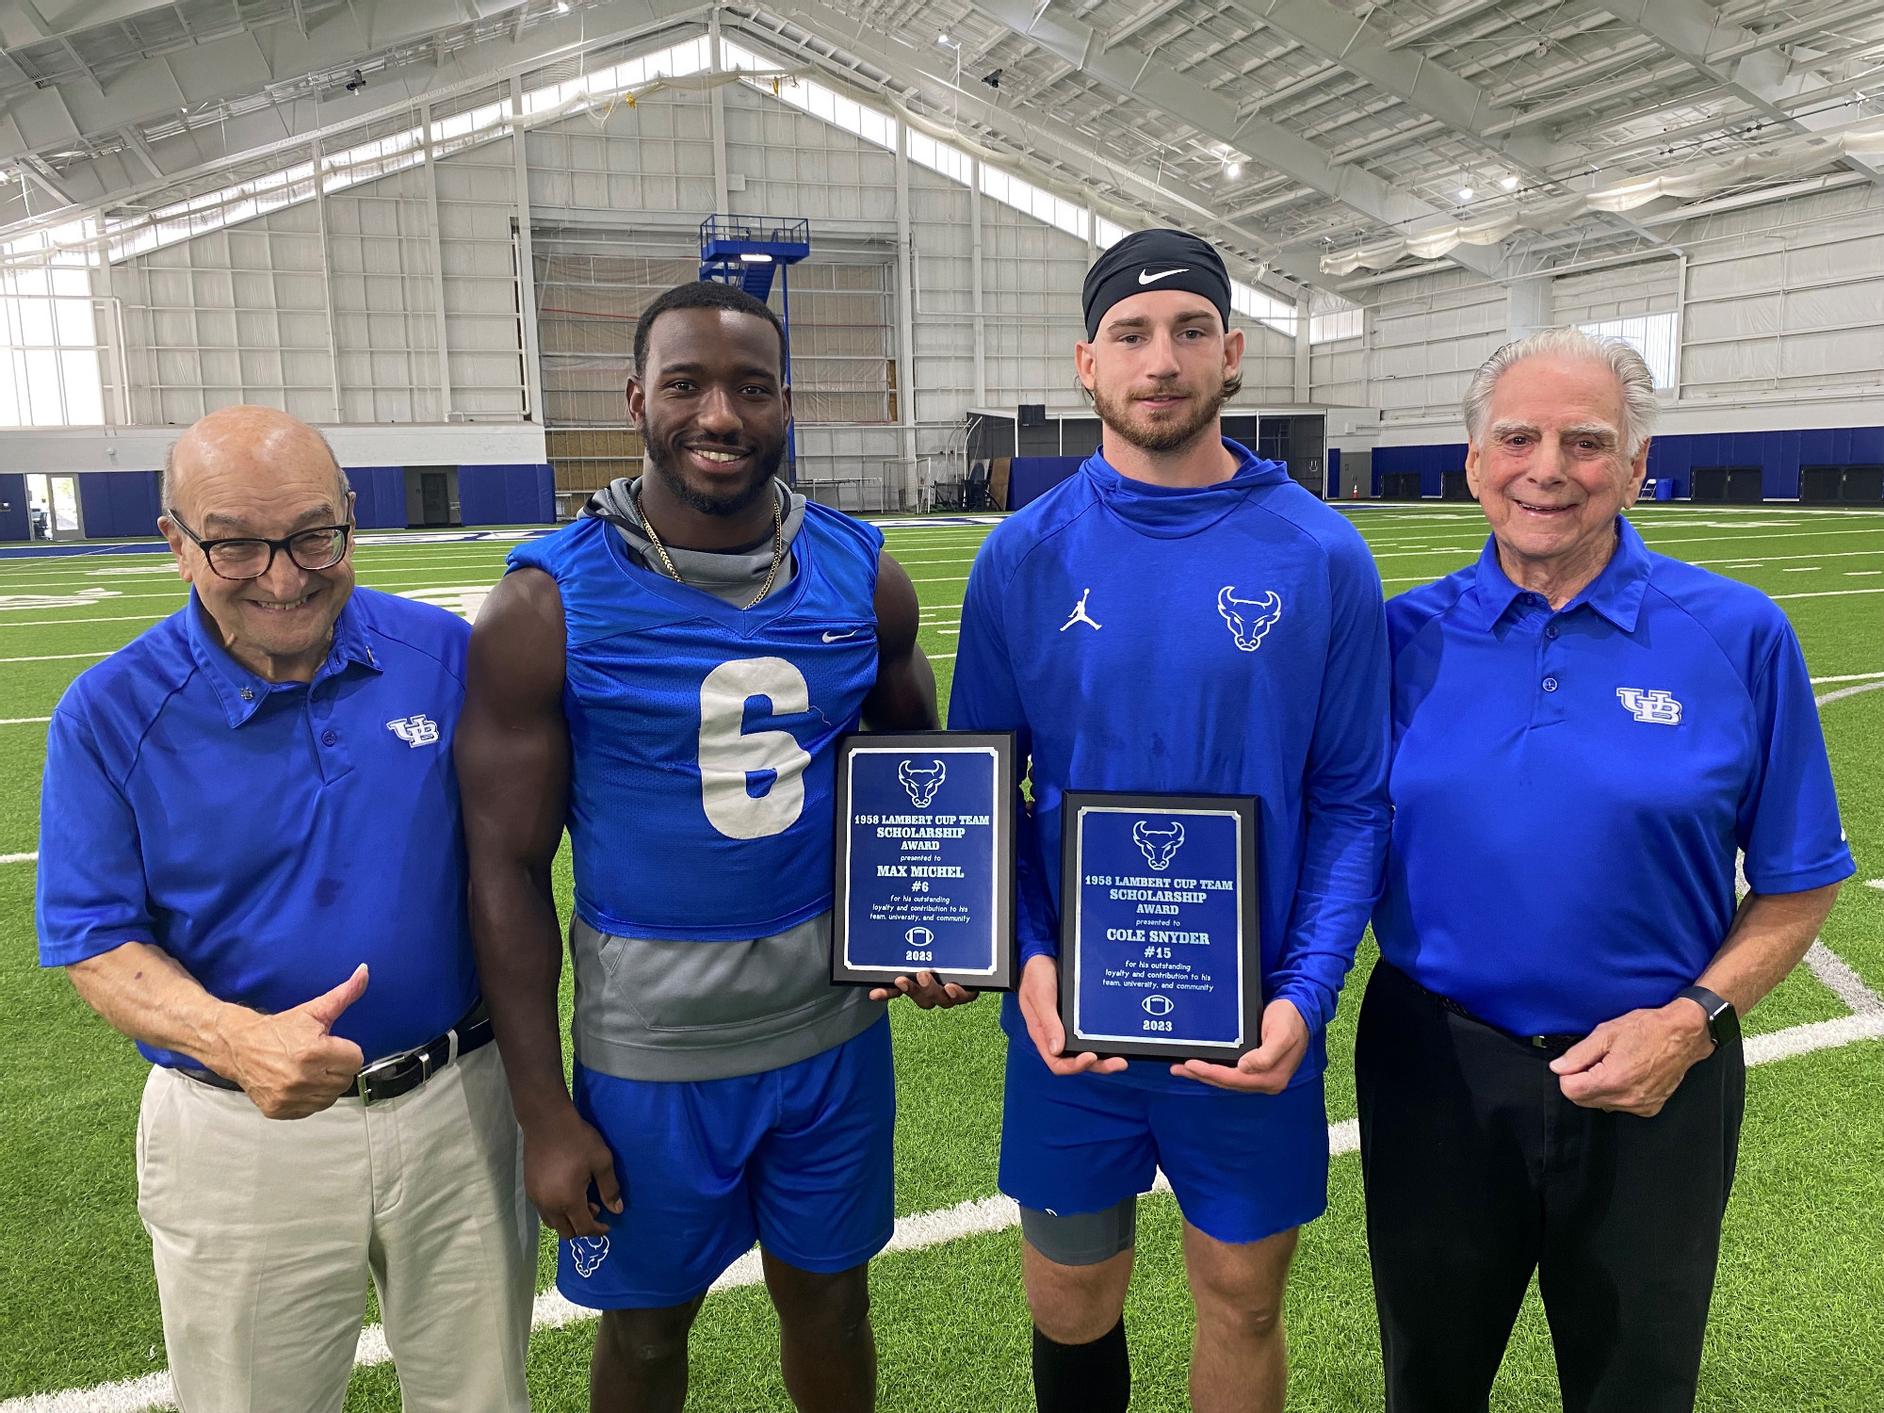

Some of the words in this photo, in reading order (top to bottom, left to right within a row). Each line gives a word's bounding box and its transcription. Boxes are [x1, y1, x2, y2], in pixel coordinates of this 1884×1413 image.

[698, 656, 812, 840] 6
[855, 815, 879, 825] 1958
[881, 815, 933, 825] LAMBERT
[935, 815, 957, 825] CUP
[959, 815, 990, 826] TEAM
[876, 827, 966, 839] SCHOLARSHIP
[900, 841, 940, 851] AWARD
[900, 855, 932, 863] presented
[876, 865, 908, 877] MAX
[910, 866, 965, 879] MICHEL
[911, 881, 929, 893] #6
[1085, 874, 1113, 886] 1958
[1114, 876, 1172, 888] LAMBERT
[1173, 879, 1198, 889] CUP
[1199, 879, 1234, 891] TEAM
[902, 895, 912, 903] his
[913, 895, 951, 905] outstanding
[1109, 888, 1208, 904] SCHOLARSHIP
[872, 903, 894, 912] loyalty
[910, 904, 948, 913] contribution
[949, 905, 957, 913] to
[958, 905, 968, 913] his
[1136, 904, 1180, 915] AWARD
[936, 914, 971, 924] community
[1135, 919, 1171, 927] presented
[1106, 928, 1146, 942] COLE
[1149, 930, 1211, 945] SNYDER
[905, 950, 933, 962] 2023
[1143, 945, 1172, 959] #15
[1125, 960, 1137, 968] for
[1150, 962, 1192, 973] outstanding
[1105, 969, 1130, 979] loyalty
[1147, 972, 1189, 980] contribution
[1201, 973, 1211, 981] his
[1176, 983, 1215, 993] community
[1142, 1020, 1173, 1032] 2023
